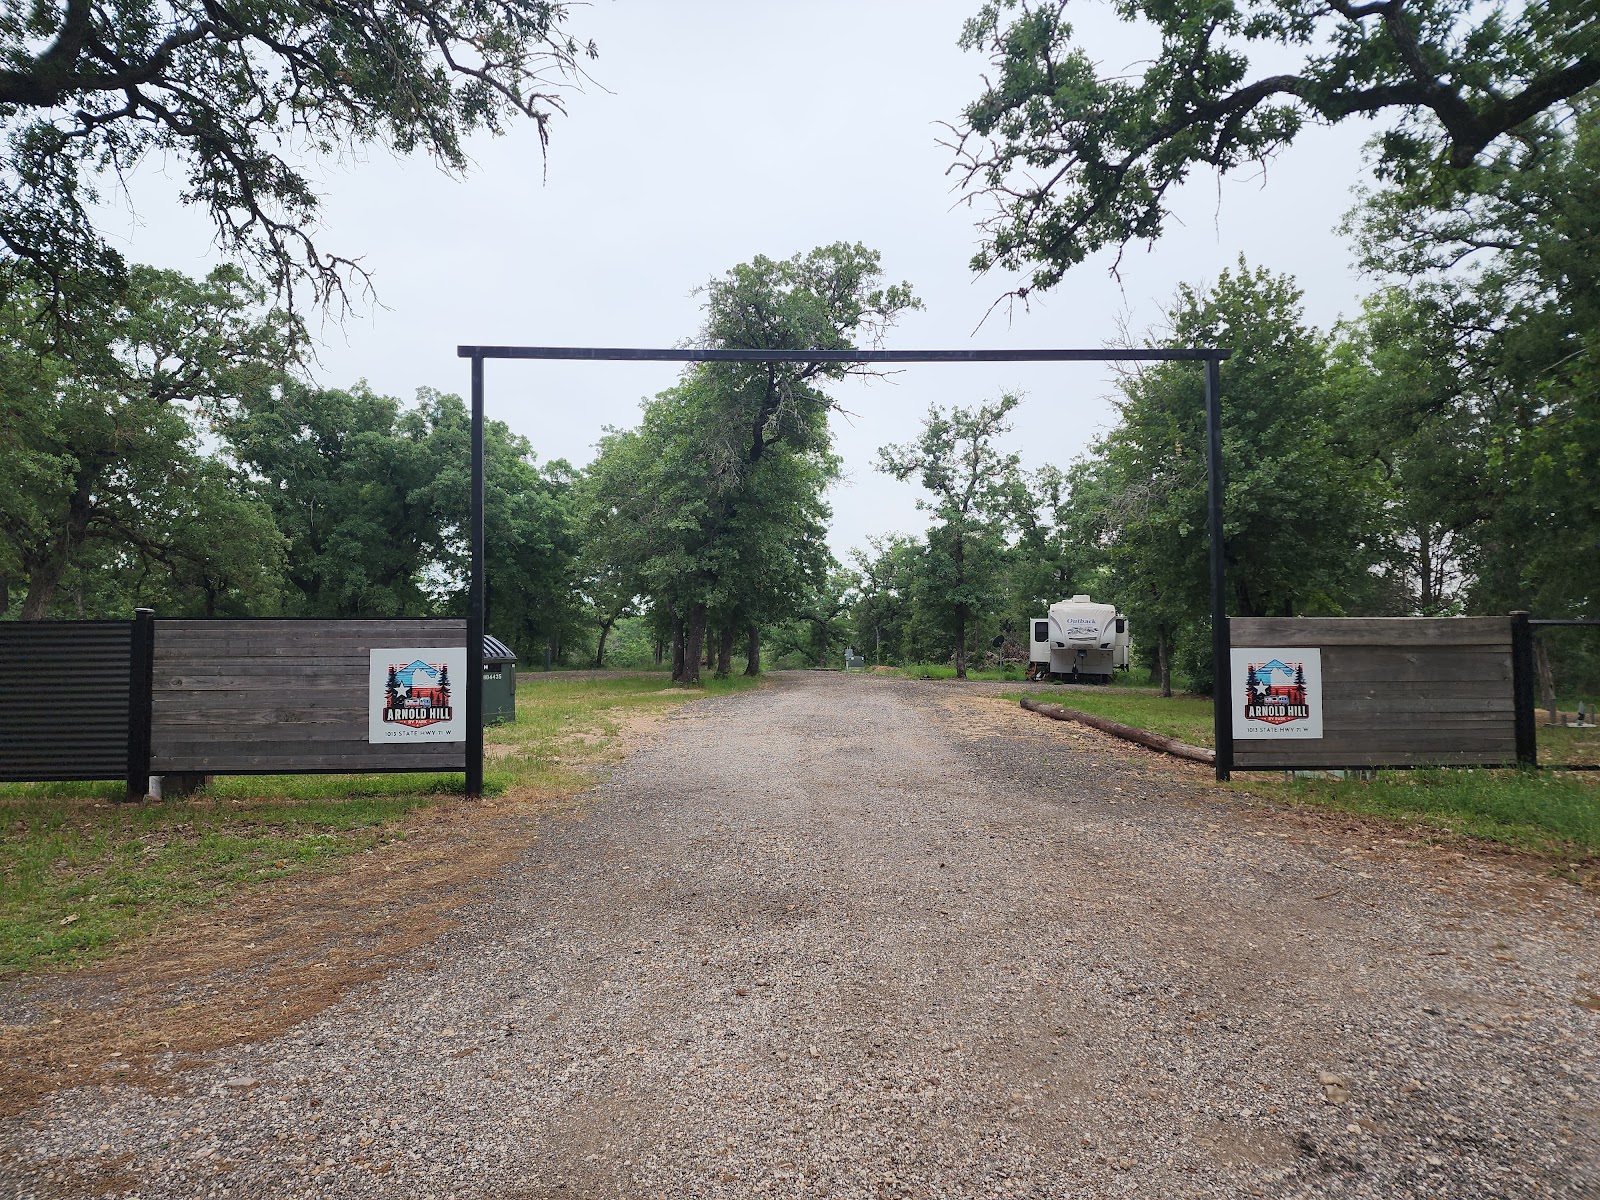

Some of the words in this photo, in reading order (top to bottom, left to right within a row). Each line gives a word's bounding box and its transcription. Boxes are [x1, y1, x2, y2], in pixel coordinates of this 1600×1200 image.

[387, 708, 427, 720] ARNOLD
[429, 708, 450, 719] HILL
[1249, 705, 1286, 717] ARNOLD
[1287, 705, 1307, 717] HILL
